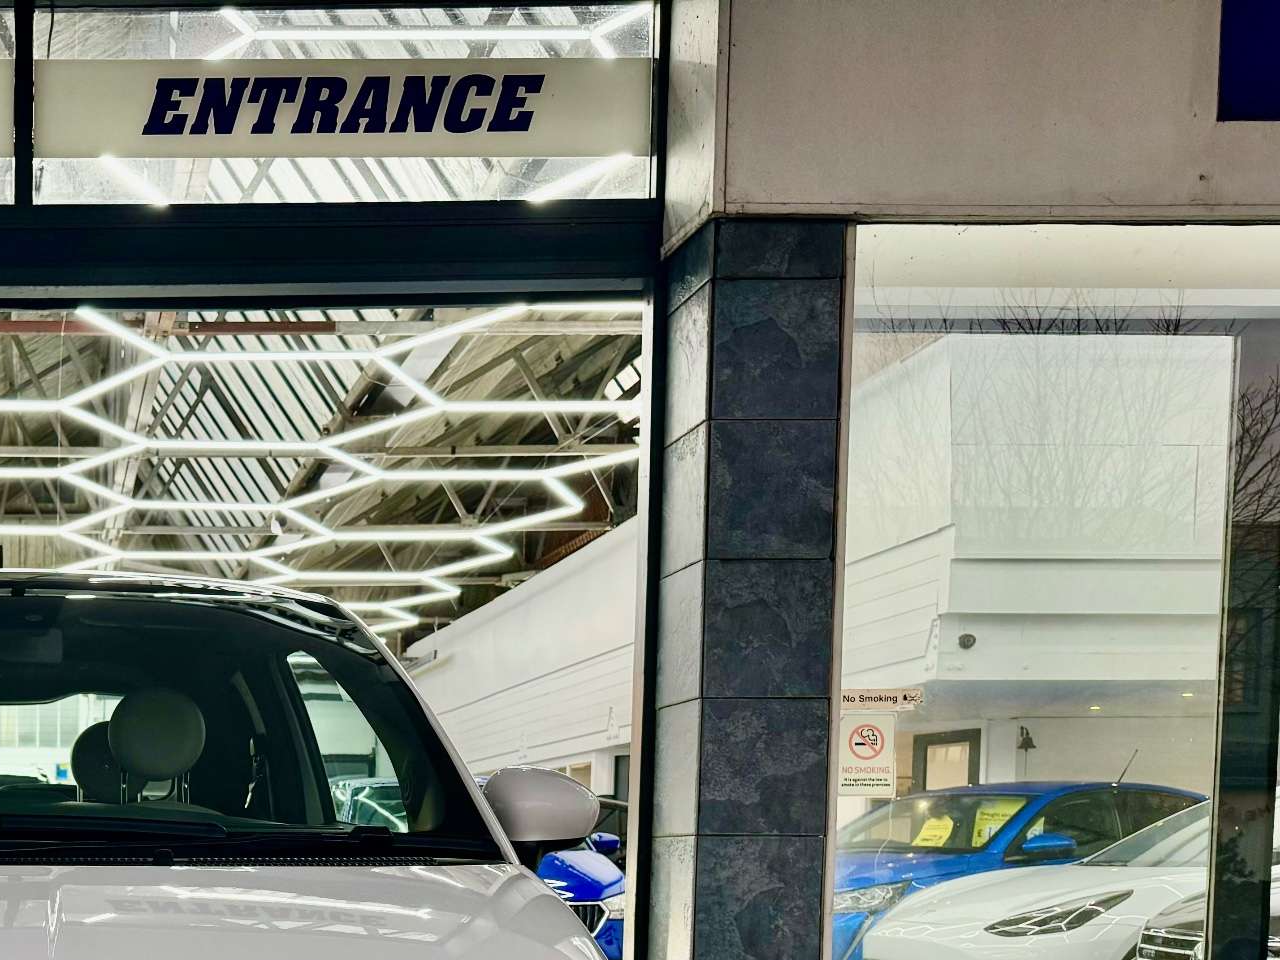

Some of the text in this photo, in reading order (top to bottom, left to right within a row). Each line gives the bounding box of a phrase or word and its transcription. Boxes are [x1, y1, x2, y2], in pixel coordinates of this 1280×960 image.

[141, 74, 546, 136] ENTRANCE
[842, 694, 898, 704] No Smoking
[841, 766, 853, 774] NO
